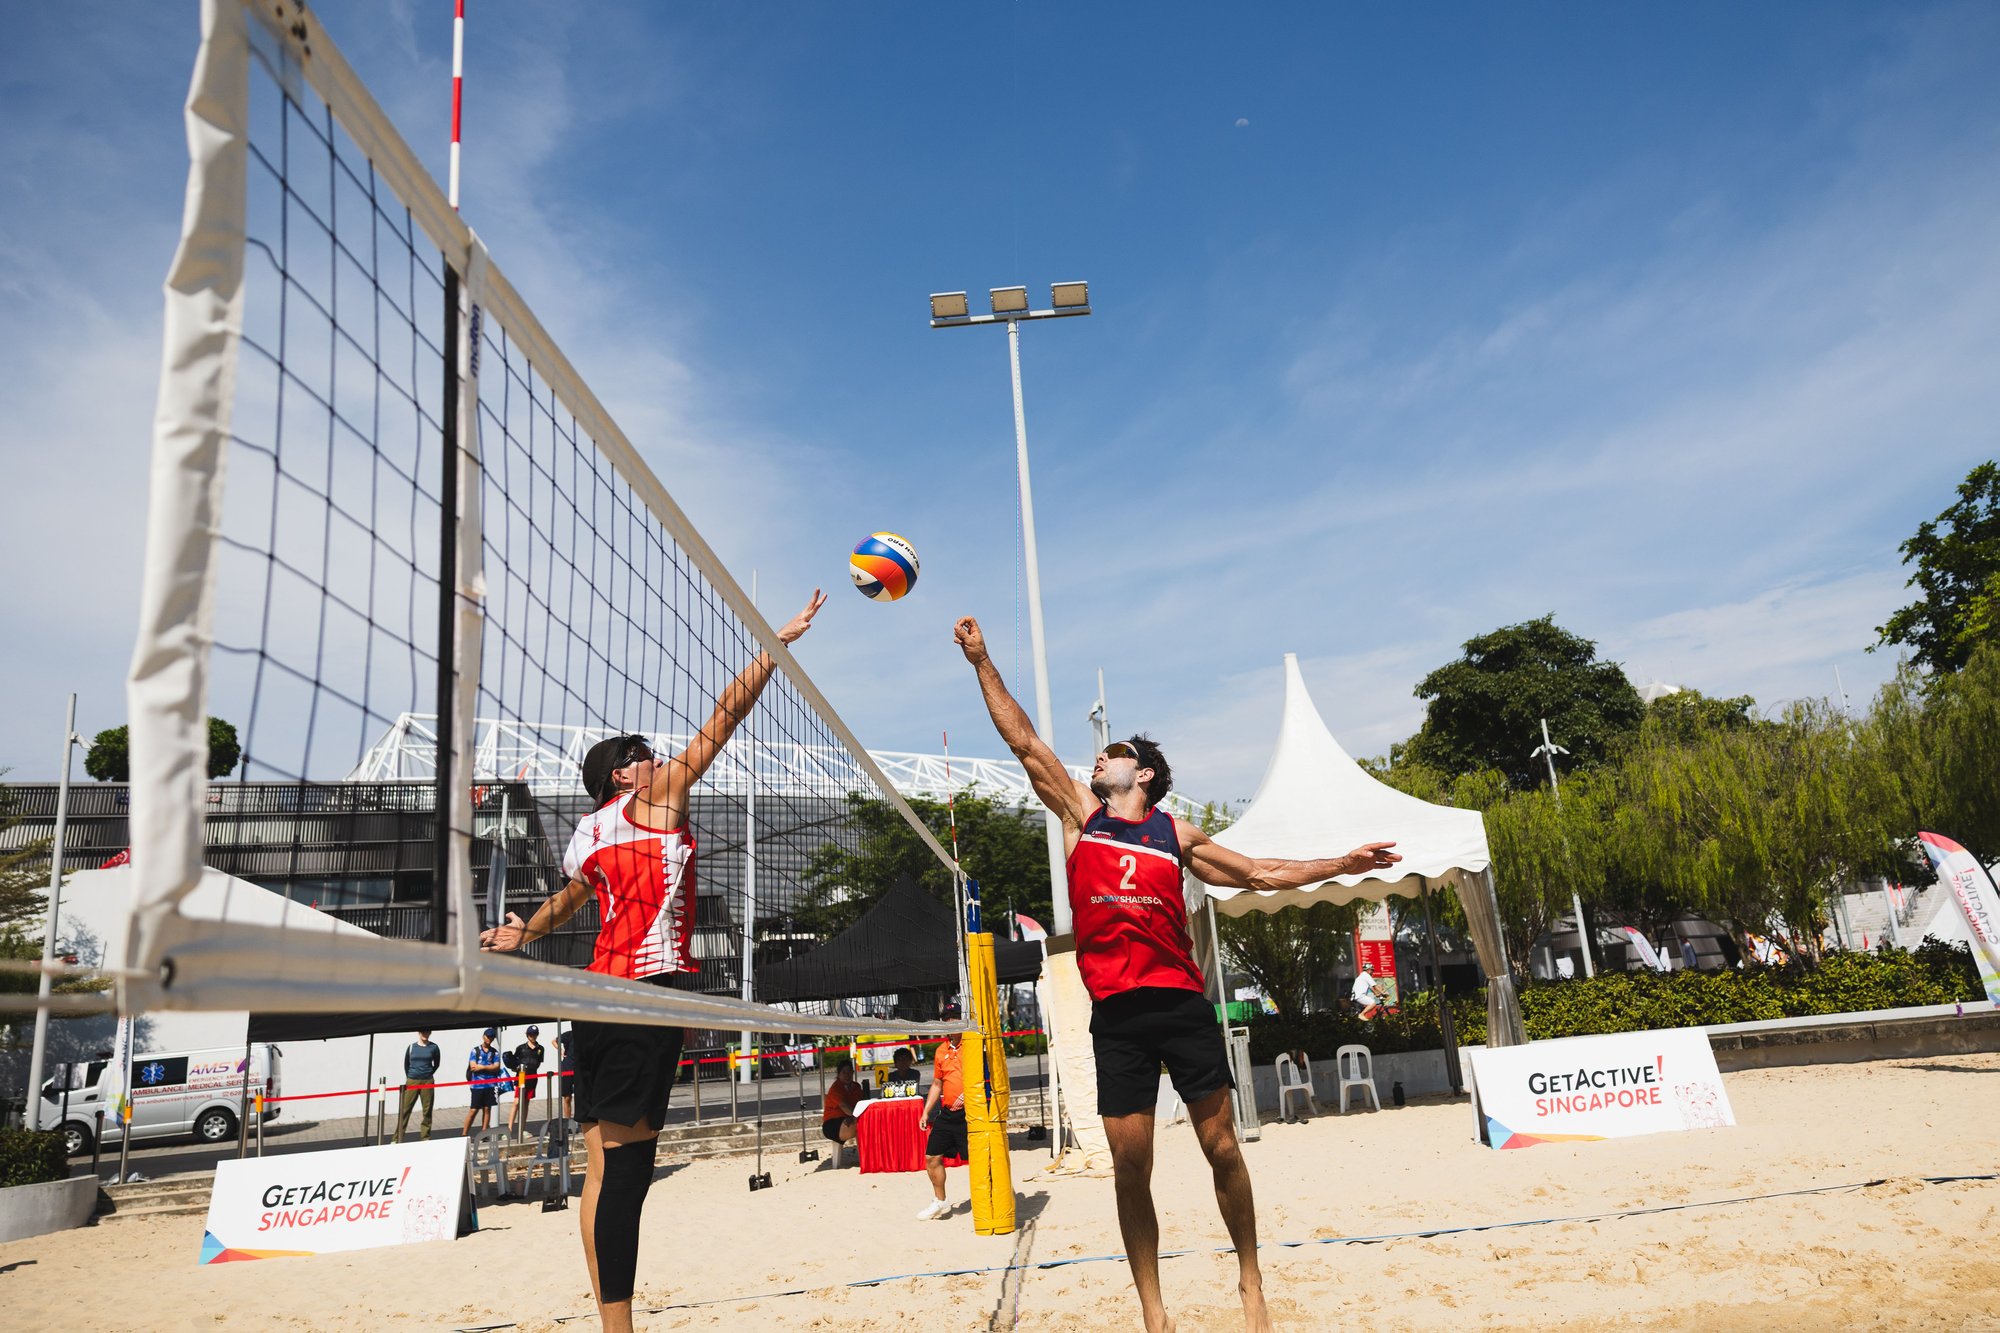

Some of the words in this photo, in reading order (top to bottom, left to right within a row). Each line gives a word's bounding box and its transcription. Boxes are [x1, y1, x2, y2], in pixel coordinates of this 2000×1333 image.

[887, 537, 904, 548] PRO
[1119, 854, 1136, 890] 2
[878, 1070, 886, 1085] 2
[132, 1085, 184, 1096] AMBULANCE
[187, 1082, 223, 1091] MEDICAL
[1536, 1087, 1662, 1117] SINGAPORE
[257, 1200, 394, 1232] SINGAPORE
